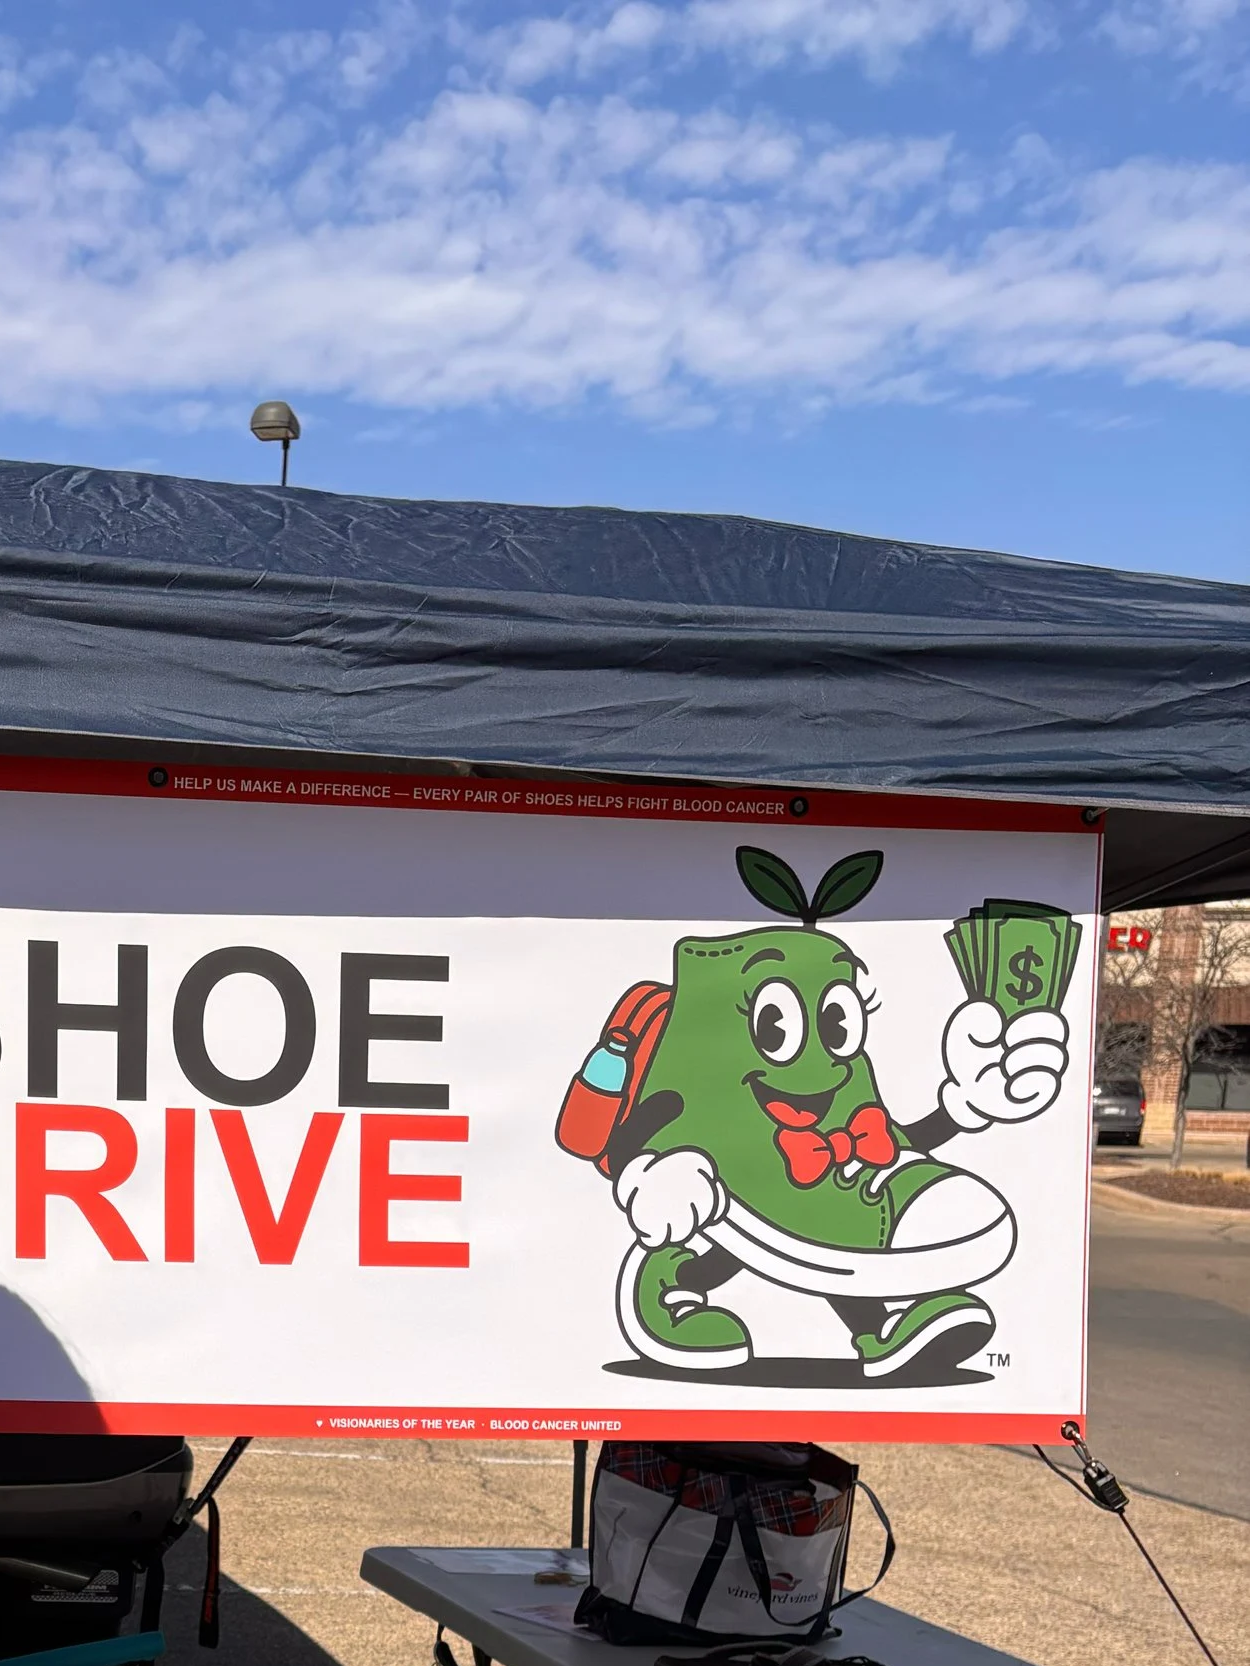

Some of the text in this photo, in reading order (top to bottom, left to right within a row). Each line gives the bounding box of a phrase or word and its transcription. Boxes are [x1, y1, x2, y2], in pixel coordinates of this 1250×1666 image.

[174, 777, 212, 790] HELP
[217, 778, 236, 791] US
[241, 779, 282, 793] MAKE
[286, 781, 297, 794] A
[301, 782, 391, 798] DIFFERENCE
[413, 787, 461, 801] EVERY
[464, 790, 498, 803] PAIR
[502, 791, 521, 804] OF
[525, 792, 574, 806] SHOES
[578, 795, 624, 808] HELPS
[628, 797, 669, 810] FIGHT
[673, 799, 722, 812] BLOOD
[726, 801, 785, 815] CANCER
[986, 1353, 1010, 1367] TM
[329, 1418, 622, 1431] VISIONARIES OF THE YEAR BLOOD CANCER UNITED
